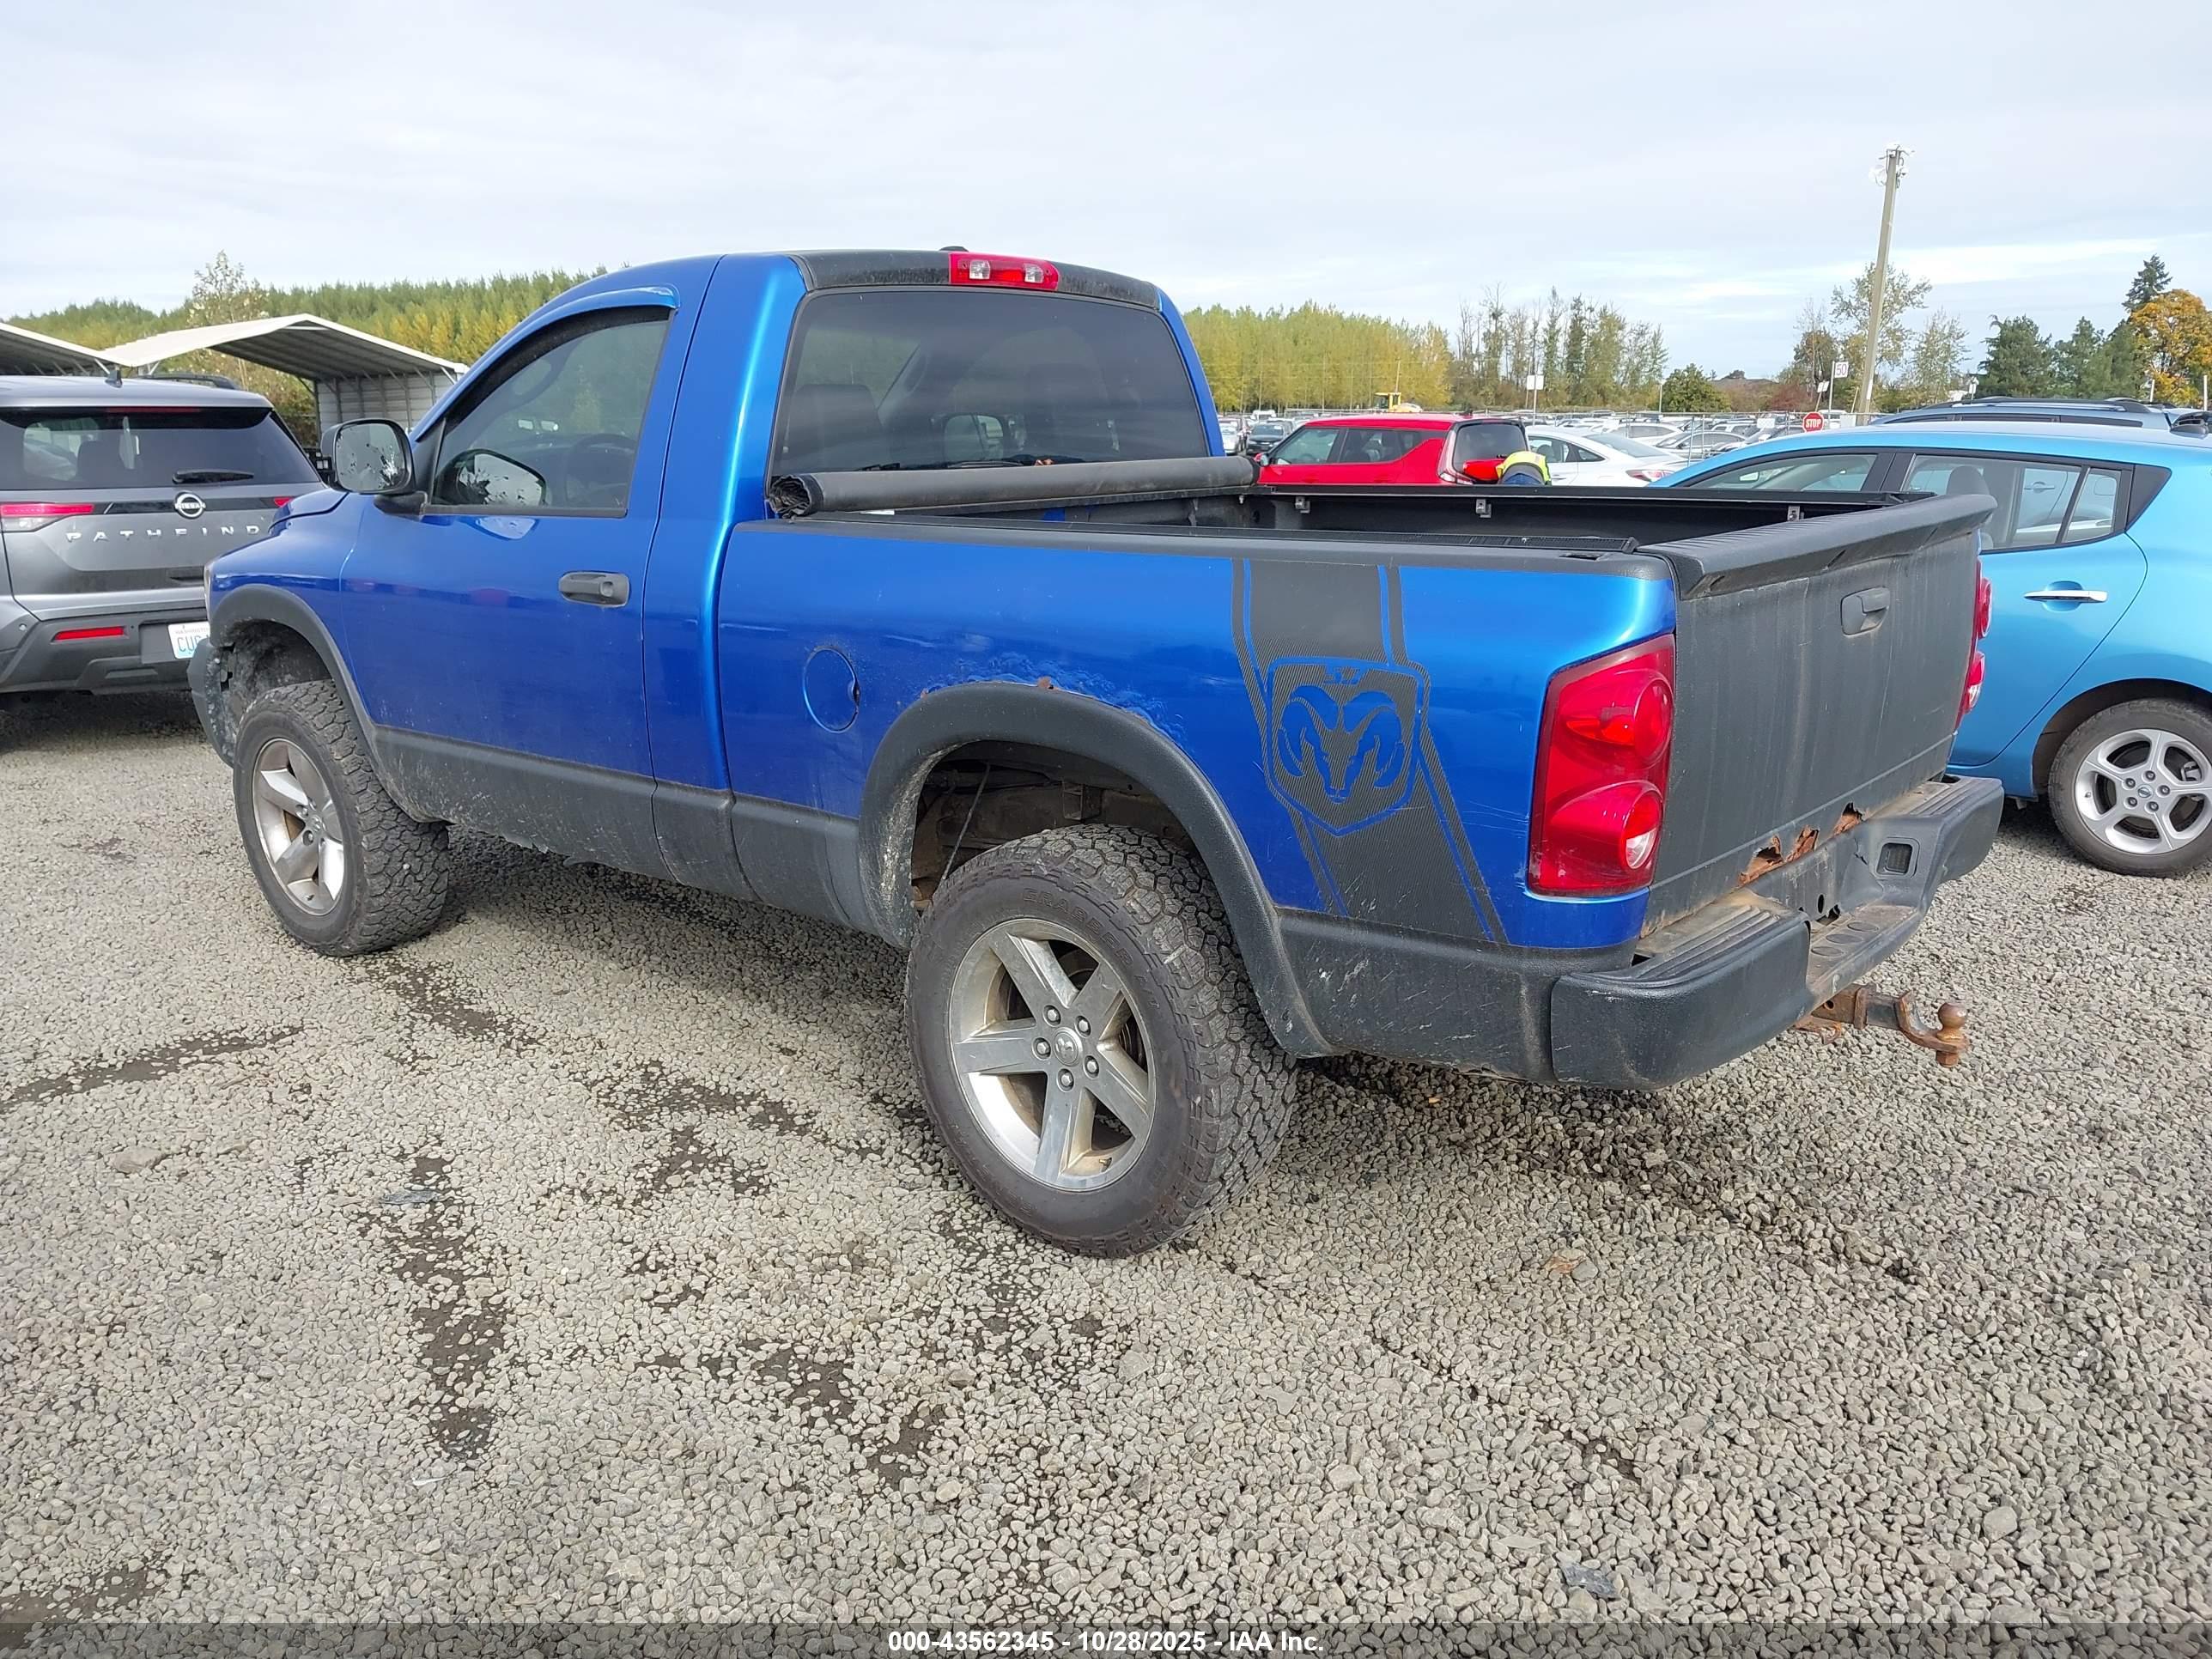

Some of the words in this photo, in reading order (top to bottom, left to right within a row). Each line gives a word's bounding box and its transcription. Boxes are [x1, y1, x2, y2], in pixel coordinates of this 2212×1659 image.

[1836, 363, 1848, 376] 50
[1805, 418, 1822, 428] STOP
[1022, 888, 1133, 967] GRABBER
